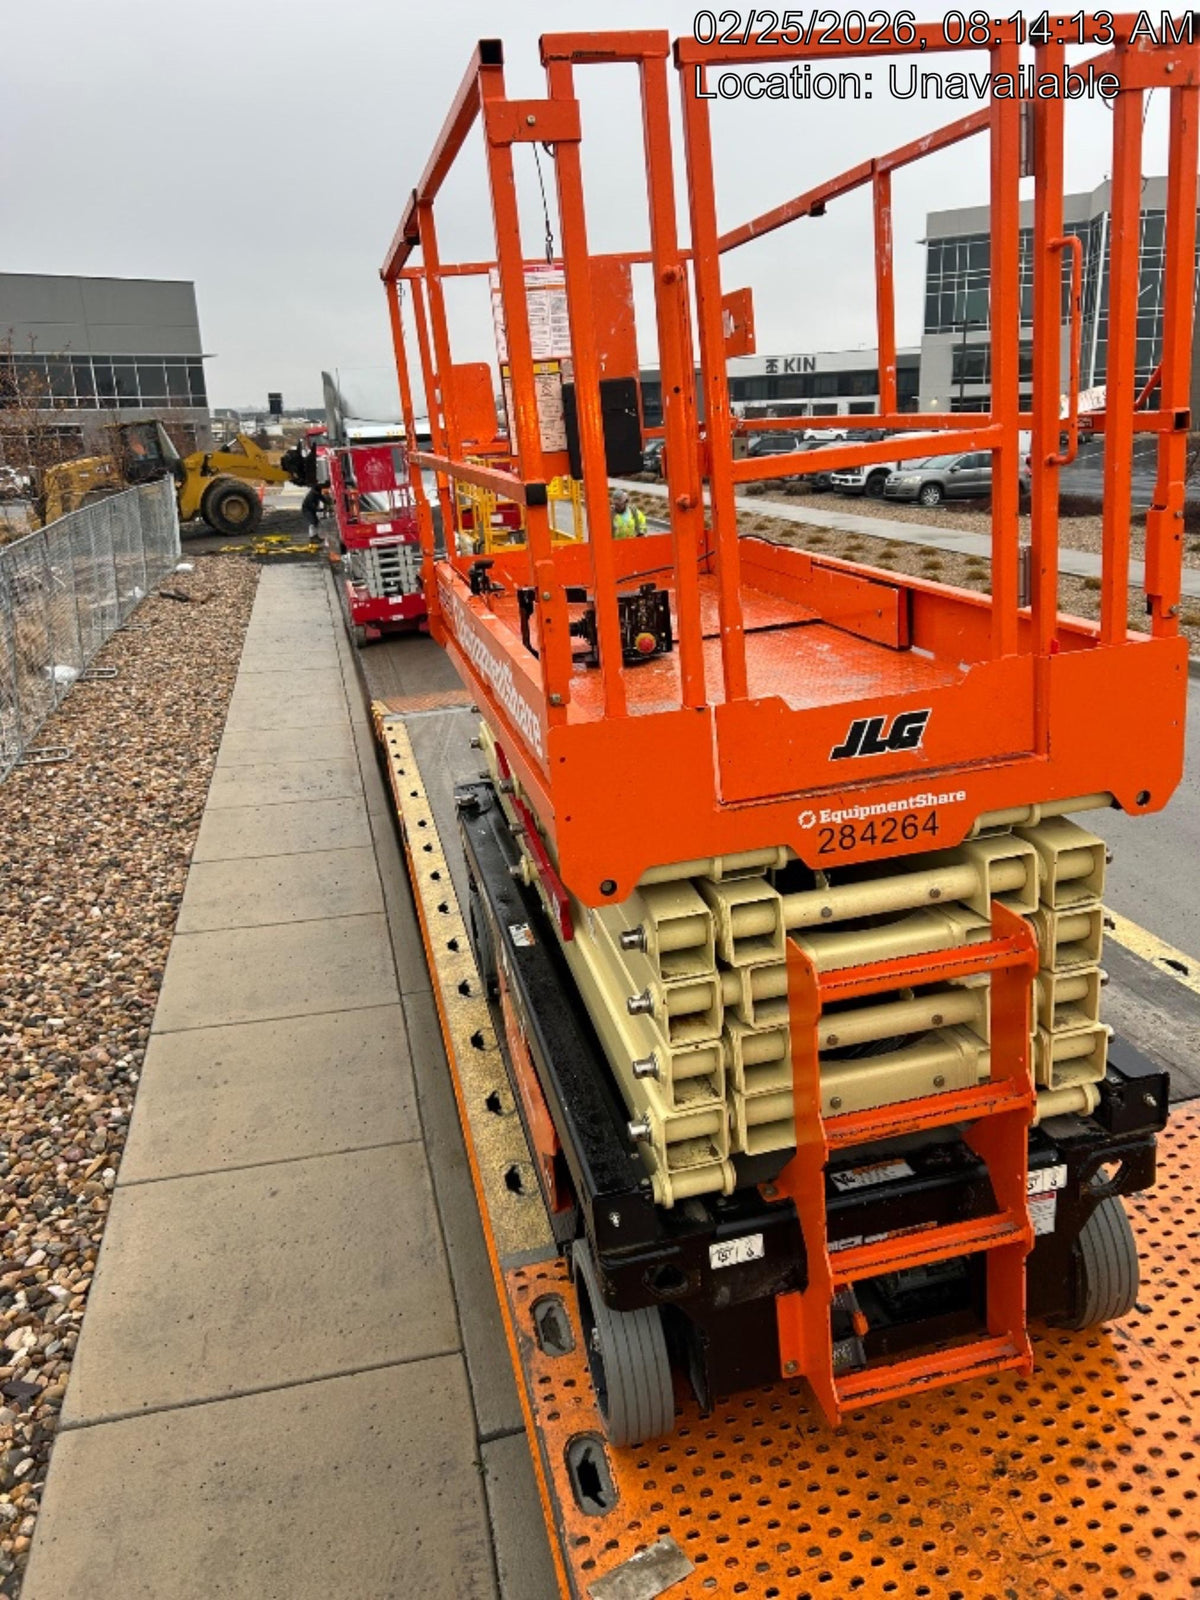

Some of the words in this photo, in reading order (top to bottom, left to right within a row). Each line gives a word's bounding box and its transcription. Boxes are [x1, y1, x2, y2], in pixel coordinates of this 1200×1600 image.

[783, 356, 817, 373] KIN
[828, 708, 933, 761] JLG
[819, 790, 967, 824] EquipmentShare
[817, 810, 940, 854] 284264
